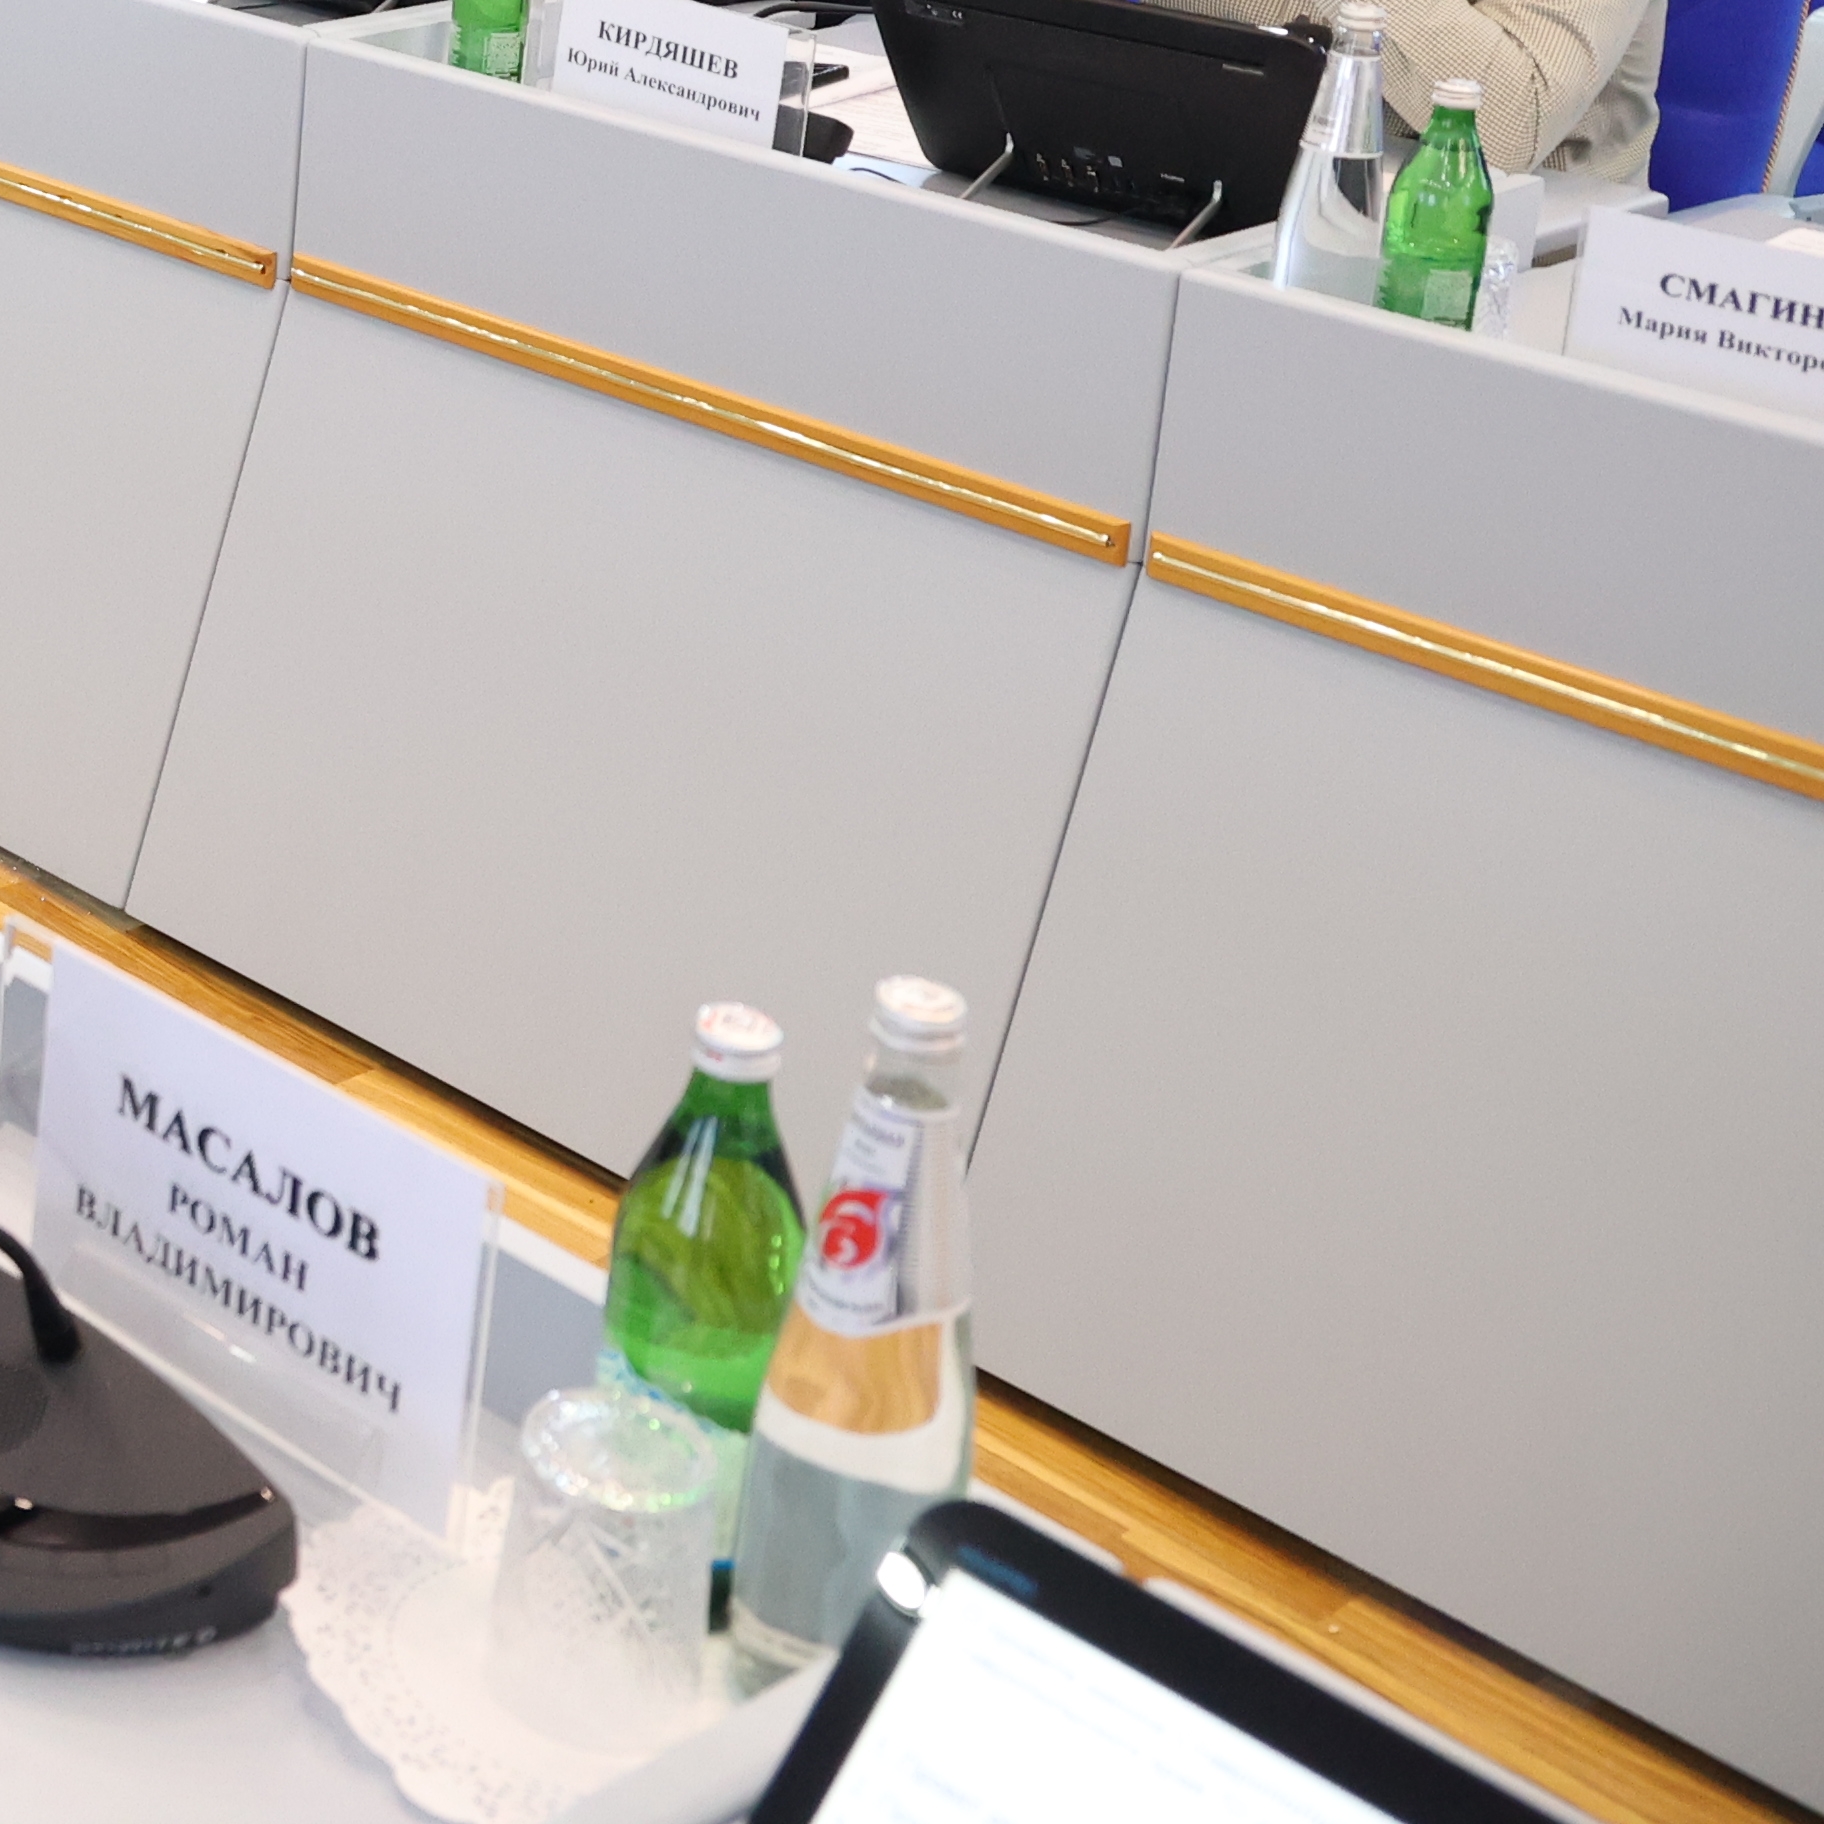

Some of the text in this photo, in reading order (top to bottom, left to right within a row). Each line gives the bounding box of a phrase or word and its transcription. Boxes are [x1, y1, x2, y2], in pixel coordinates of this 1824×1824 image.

[567, 47, 761, 121] Юрий Александрович
[598, 20, 739, 79] КИРДЯШЕВ
[1618, 306, 1708, 345] Мария
[118, 1073, 380, 1263] МАСАЛОВ
[167, 1182, 310, 1293] РОМАН
[75, 1183, 401, 1413] ВЛАДИМИРОВИЧ
